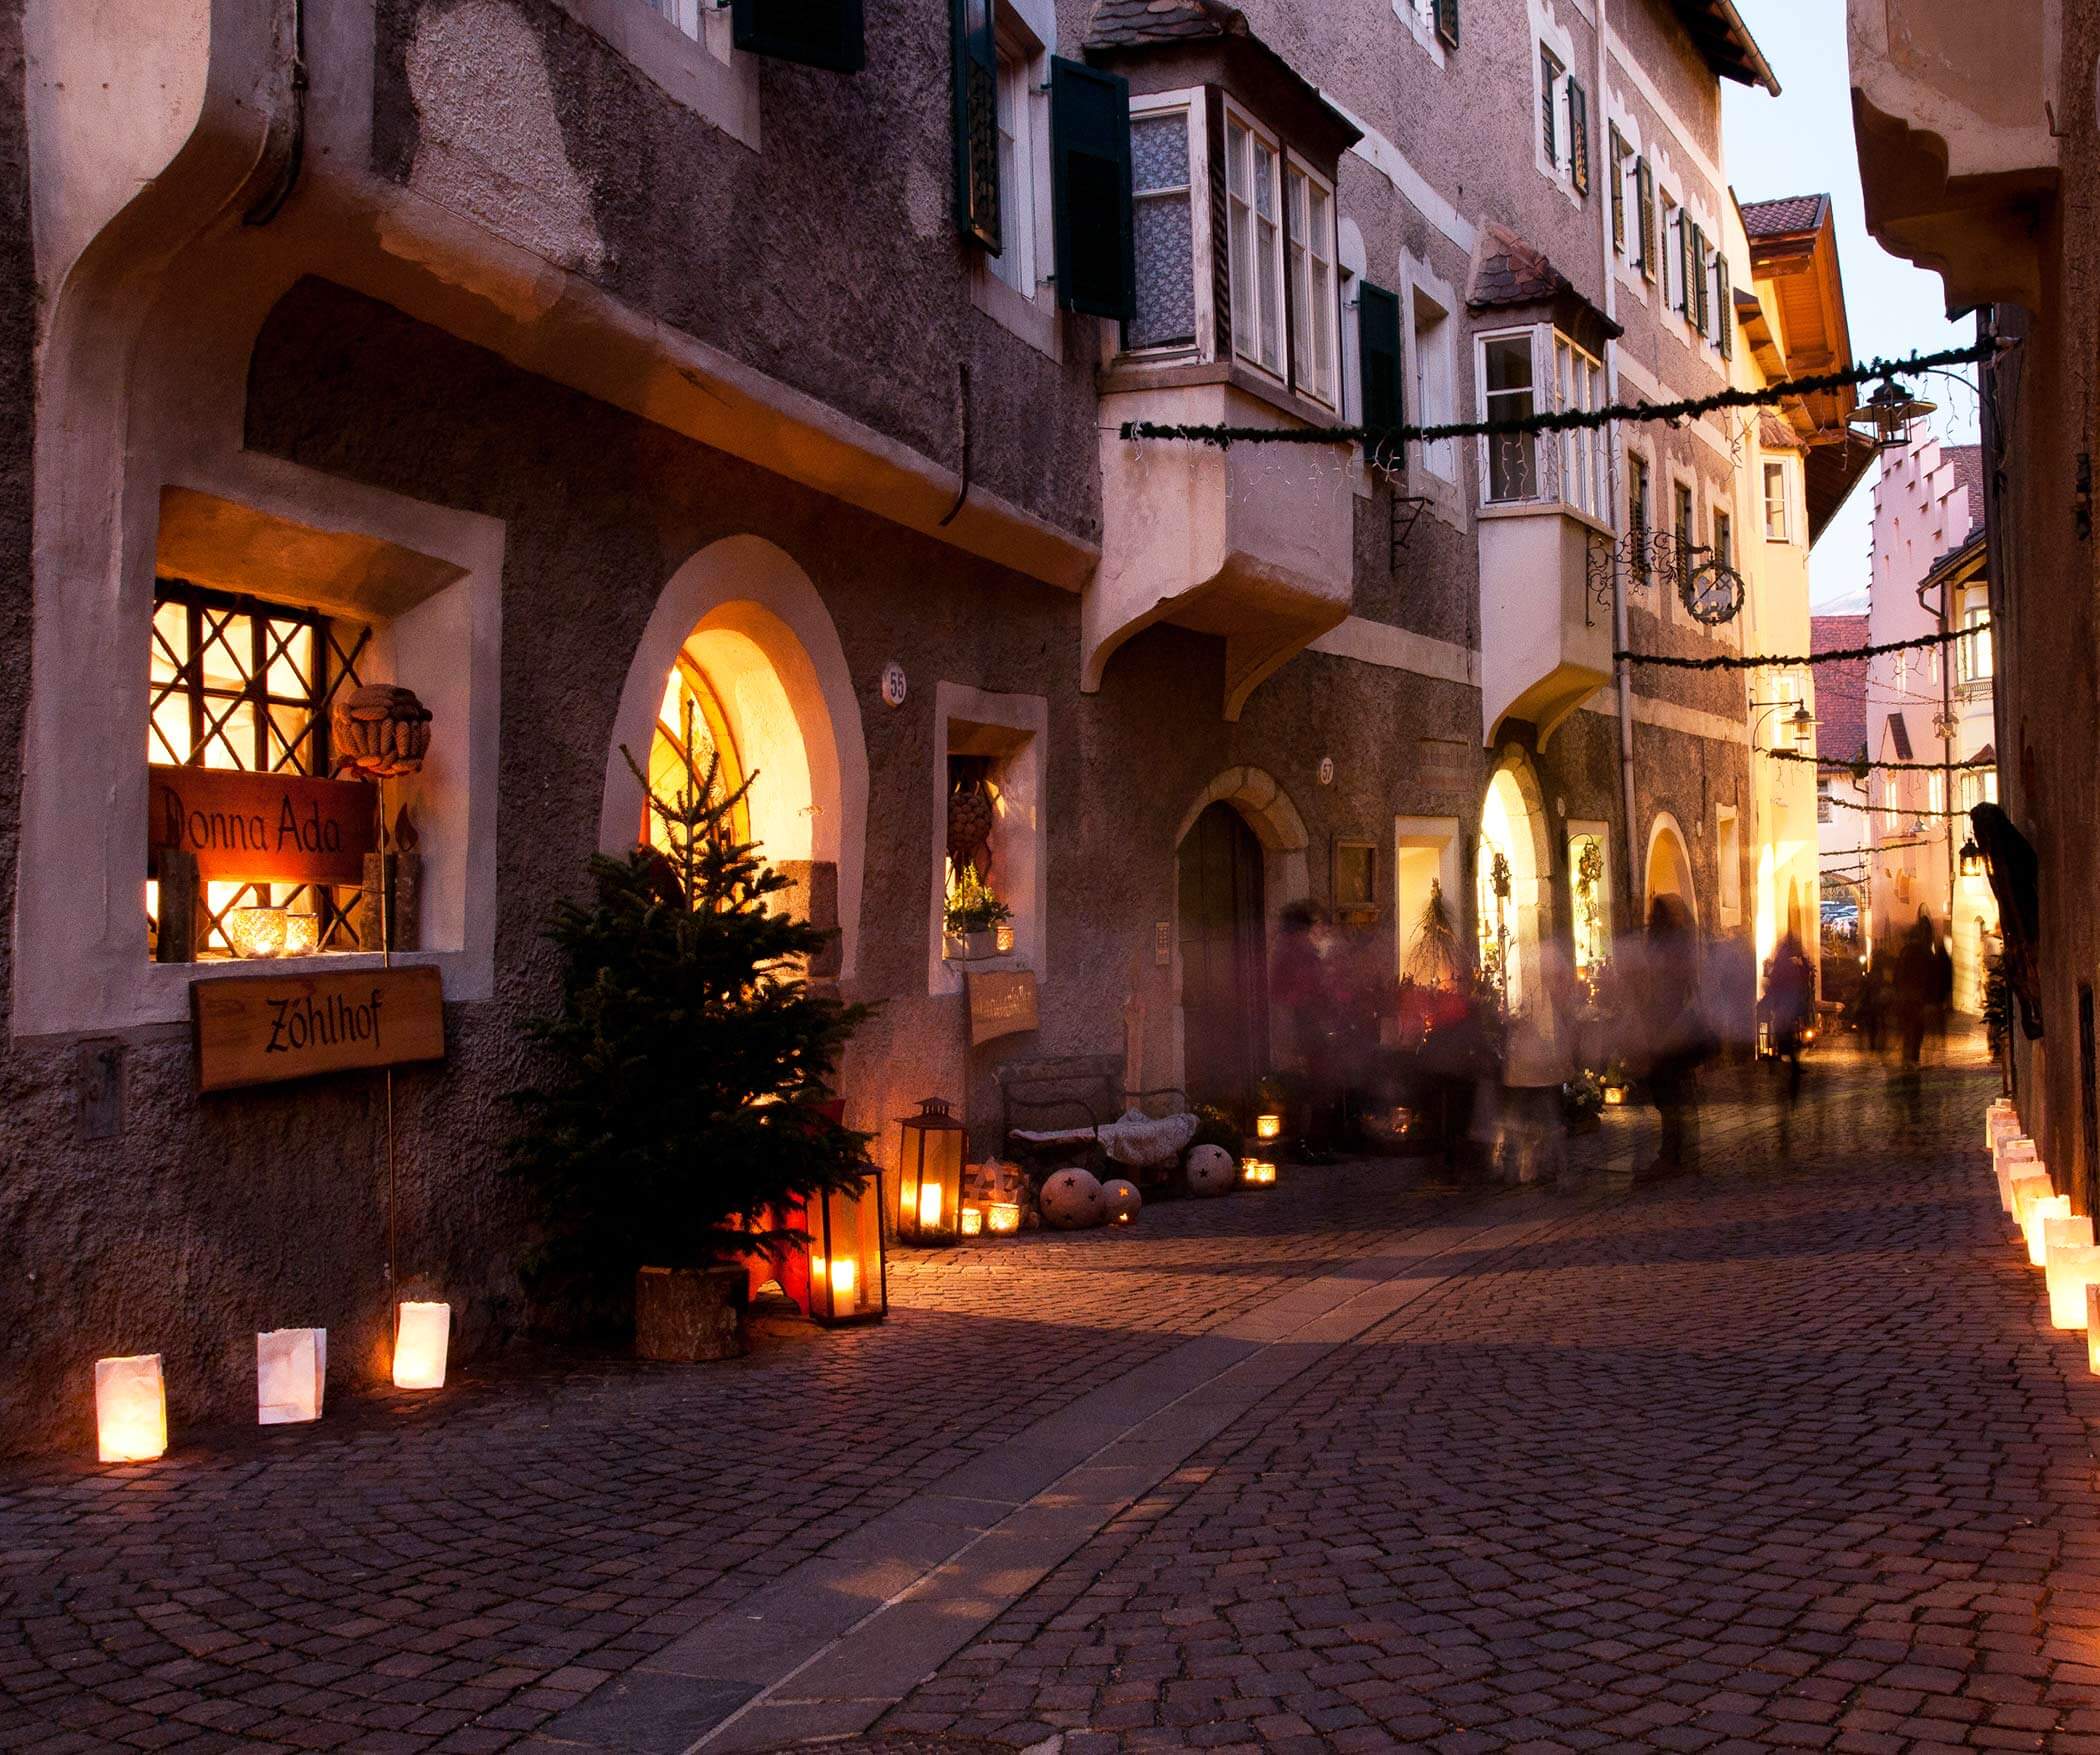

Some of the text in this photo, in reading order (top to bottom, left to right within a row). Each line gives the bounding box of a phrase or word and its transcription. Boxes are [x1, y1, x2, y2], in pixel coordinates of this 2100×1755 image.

[890, 671, 904, 698] 55
[154, 785, 343, 853] Donna Ada
[264, 986, 383, 1054] Zöhlhof
